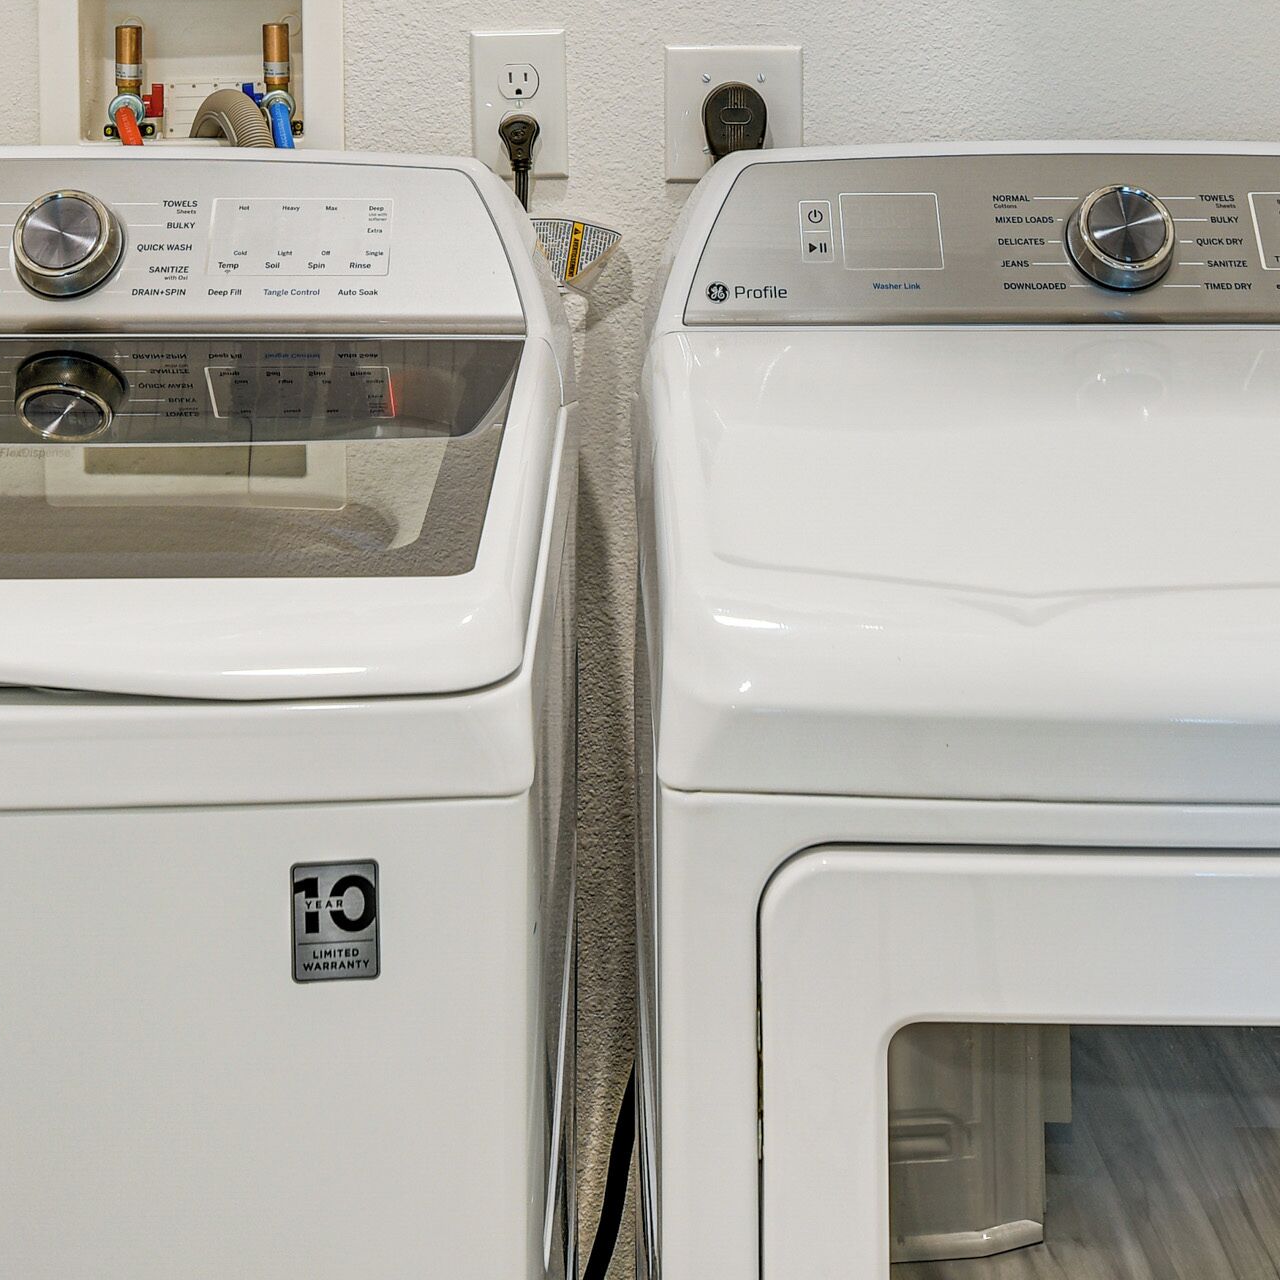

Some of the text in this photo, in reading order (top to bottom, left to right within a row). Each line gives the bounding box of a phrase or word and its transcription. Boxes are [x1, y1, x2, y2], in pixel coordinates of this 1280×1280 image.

[1199, 194, 1235, 202] TOWELS
[1025, 216, 1054, 224] LOADS
[997, 238, 1045, 246] DELICATES
[1196, 238, 1224, 246] QUICK
[137, 244, 165, 252] QUICK
[218, 261, 239, 269] Temp
[308, 262, 325, 270] Spin
[872, 282, 921, 290] Washer Link
[1003, 282, 1067, 290] DOWNLOADED
[1204, 282, 1252, 290] TIMED DRY
[131, 288, 187, 296] DRAIN+SPIN
[207, 289, 228, 297] Deep
[263, 289, 289, 297] Tangle
[734, 285, 788, 299] Profile
[293, 874, 376, 934] 10
[305, 899, 344, 910] YEAR
[312, 948, 360, 960] LIMITED
[303, 959, 370, 972] WARRANTY
